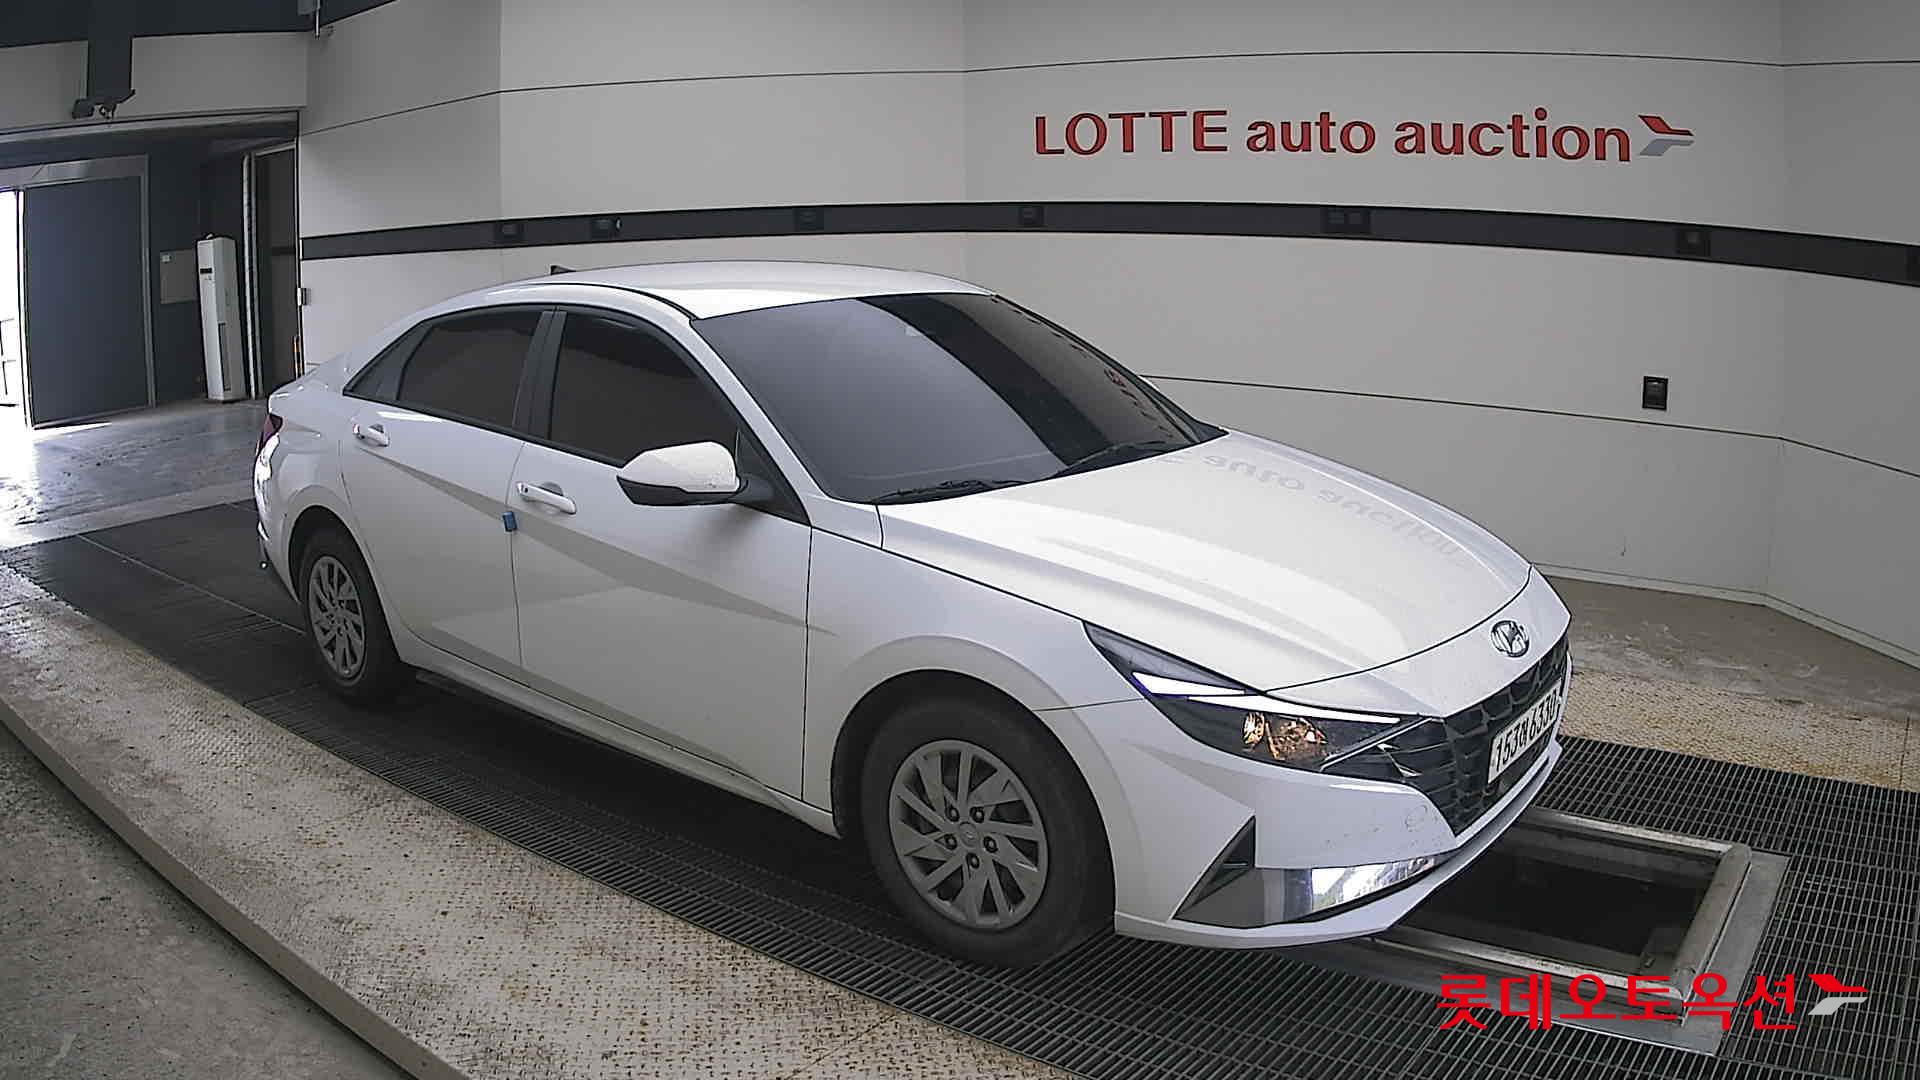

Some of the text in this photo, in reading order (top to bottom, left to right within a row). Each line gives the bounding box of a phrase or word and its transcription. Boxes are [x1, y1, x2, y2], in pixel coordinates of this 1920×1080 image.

[1034, 108, 1631, 162] LOTTE auto auction
